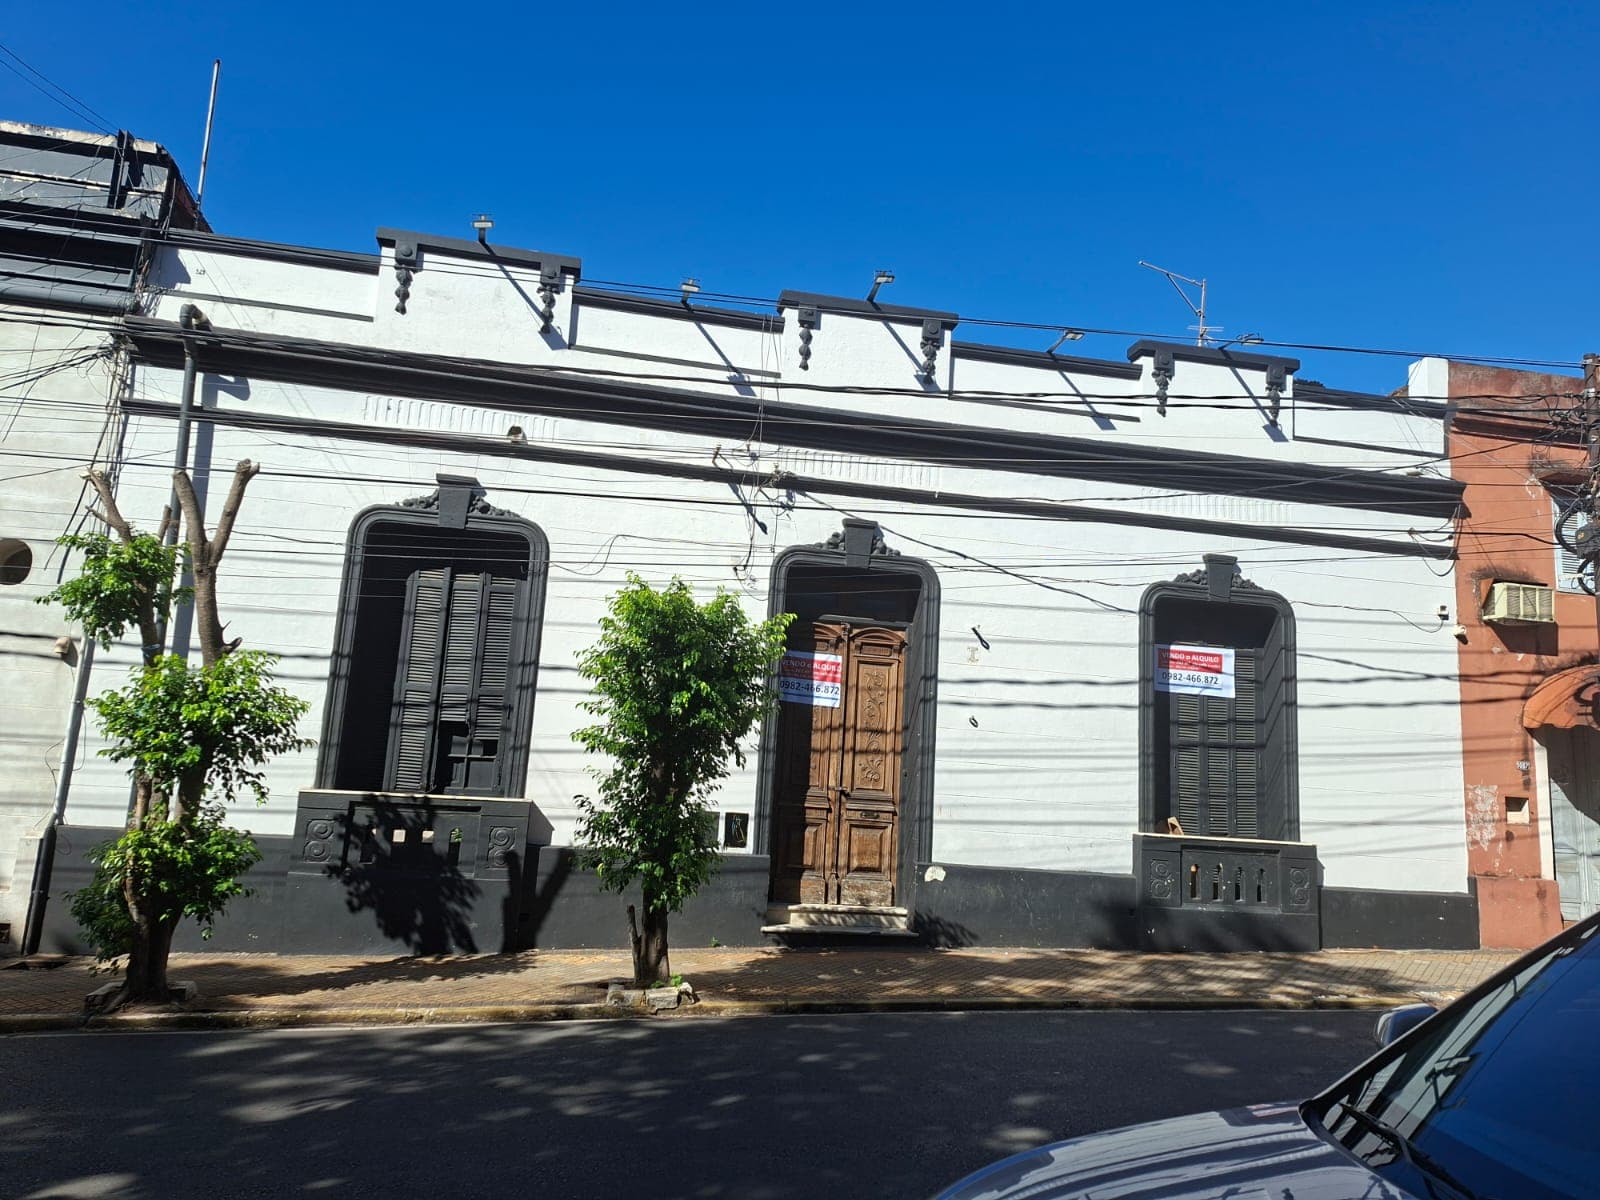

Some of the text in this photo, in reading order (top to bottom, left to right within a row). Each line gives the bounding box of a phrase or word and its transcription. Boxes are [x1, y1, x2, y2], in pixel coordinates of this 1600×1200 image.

[782, 659, 806, 668] VENDO
[813, 663, 842, 672] ALQUILO
[1191, 655, 1219, 663] ALQUILO
[780, 681, 840, 695] 0982-466.872
